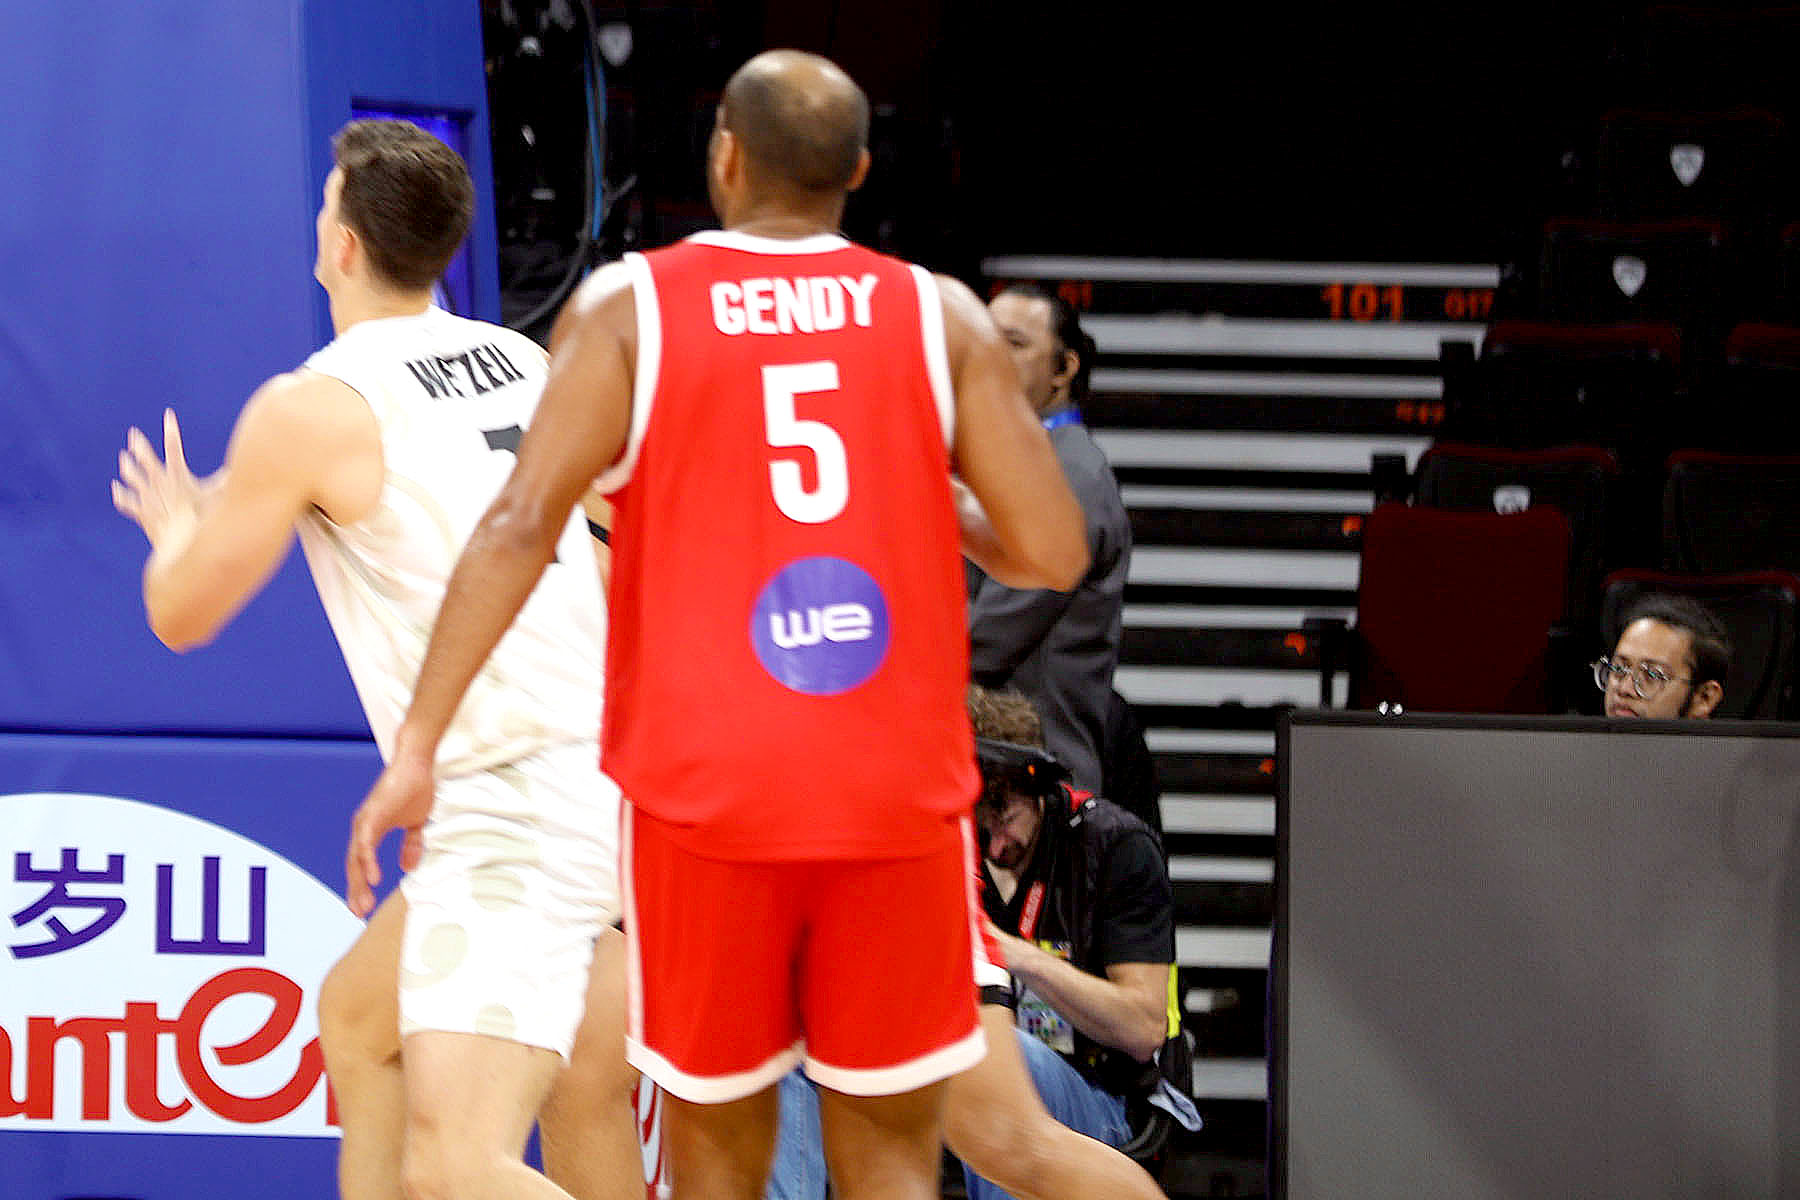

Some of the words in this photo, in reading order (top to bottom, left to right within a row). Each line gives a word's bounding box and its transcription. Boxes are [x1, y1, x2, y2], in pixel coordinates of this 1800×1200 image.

[710, 273, 879, 336] GENDY
[1321, 283, 1405, 322] 101
[403, 342, 526, 399] WEZELL
[761, 361, 850, 524] 5
